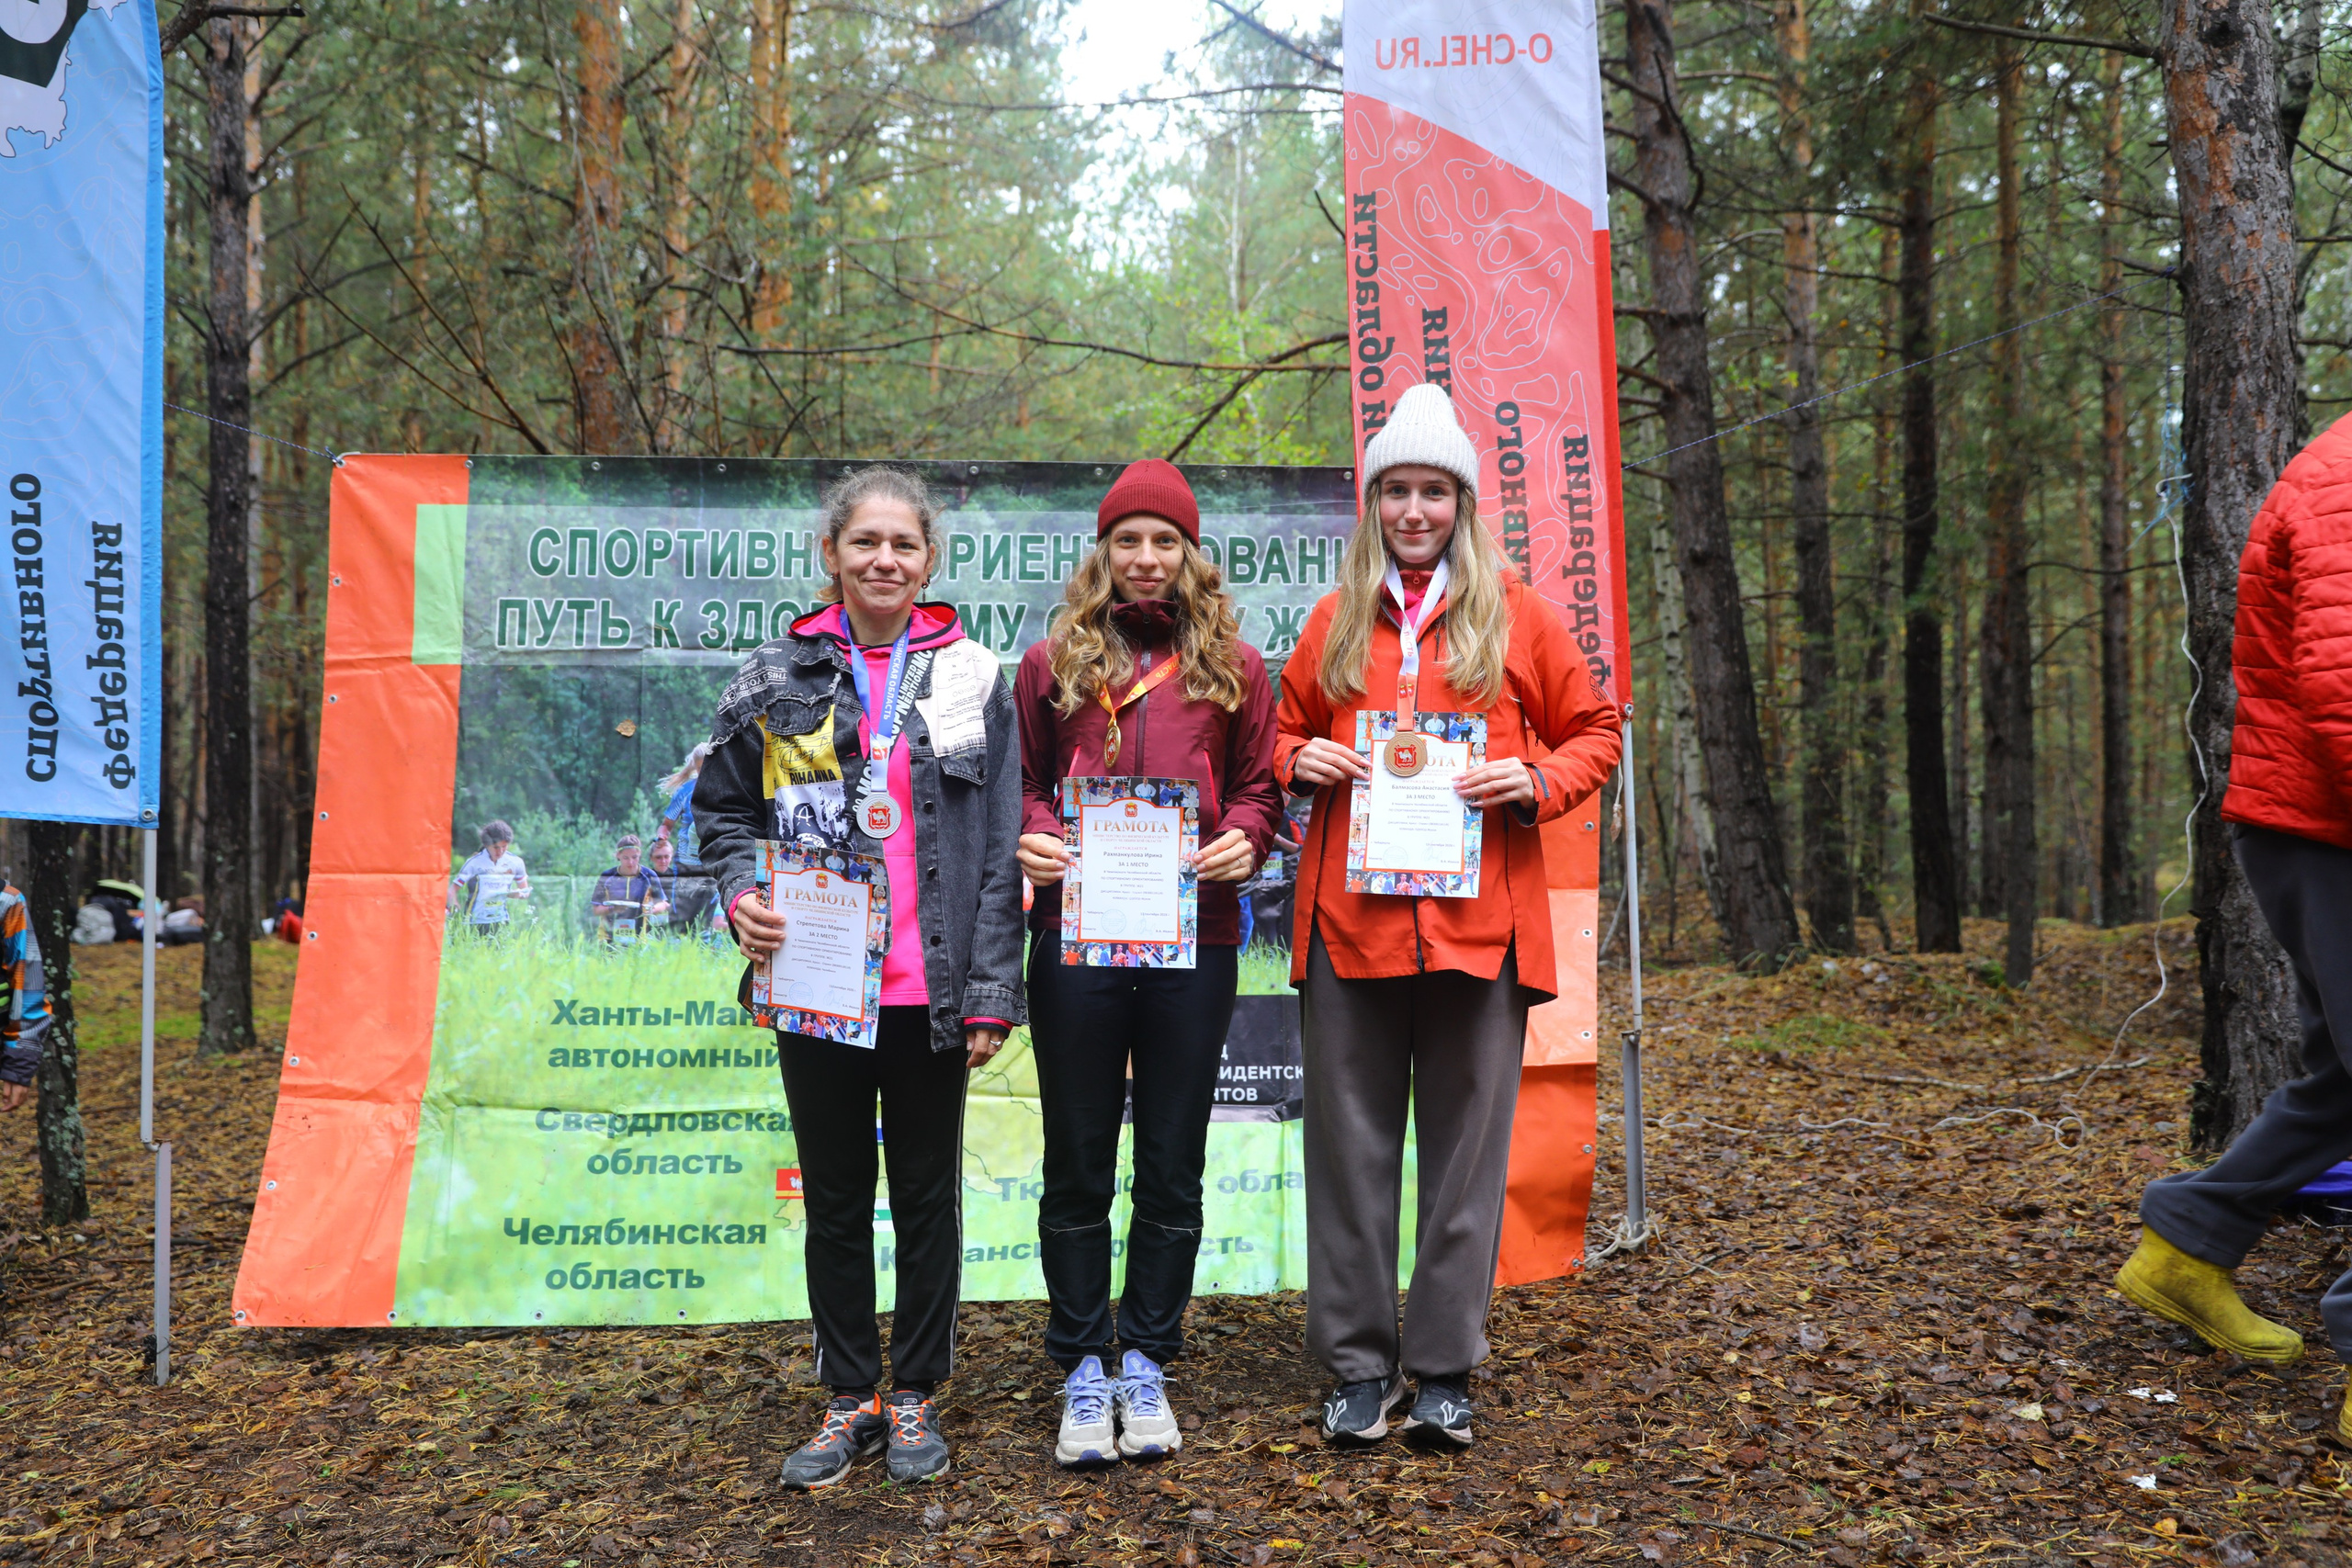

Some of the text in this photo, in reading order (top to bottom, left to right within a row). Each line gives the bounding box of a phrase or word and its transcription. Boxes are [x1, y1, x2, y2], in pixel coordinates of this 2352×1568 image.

[528, 527, 826, 580] СПОРТИВН
[495, 596, 632, 649] ПУТЬ
[652, 599, 683, 649] К
[899, 663, 917, 701] LIMITED
[905, 669, 922, 705] EDITION
[883, 681, 897, 720] ОБЛАСТЬ
[789, 768, 838, 785] RIHANNA
[1093, 820, 1169, 832] ГРАМОТА
[784, 886, 859, 908] ГРАМОТА
[796, 920, 827, 930] Стрепетова
[550, 998, 752, 1027] Ханты-Ман
[1217, 1066, 1303, 1082] ИДЕНТСК
[586, 1148, 743, 1175] область
[1217, 1169, 1304, 1194] обла
[503, 1217, 766, 1245] Челябинская
[545, 1262, 706, 1291] область
